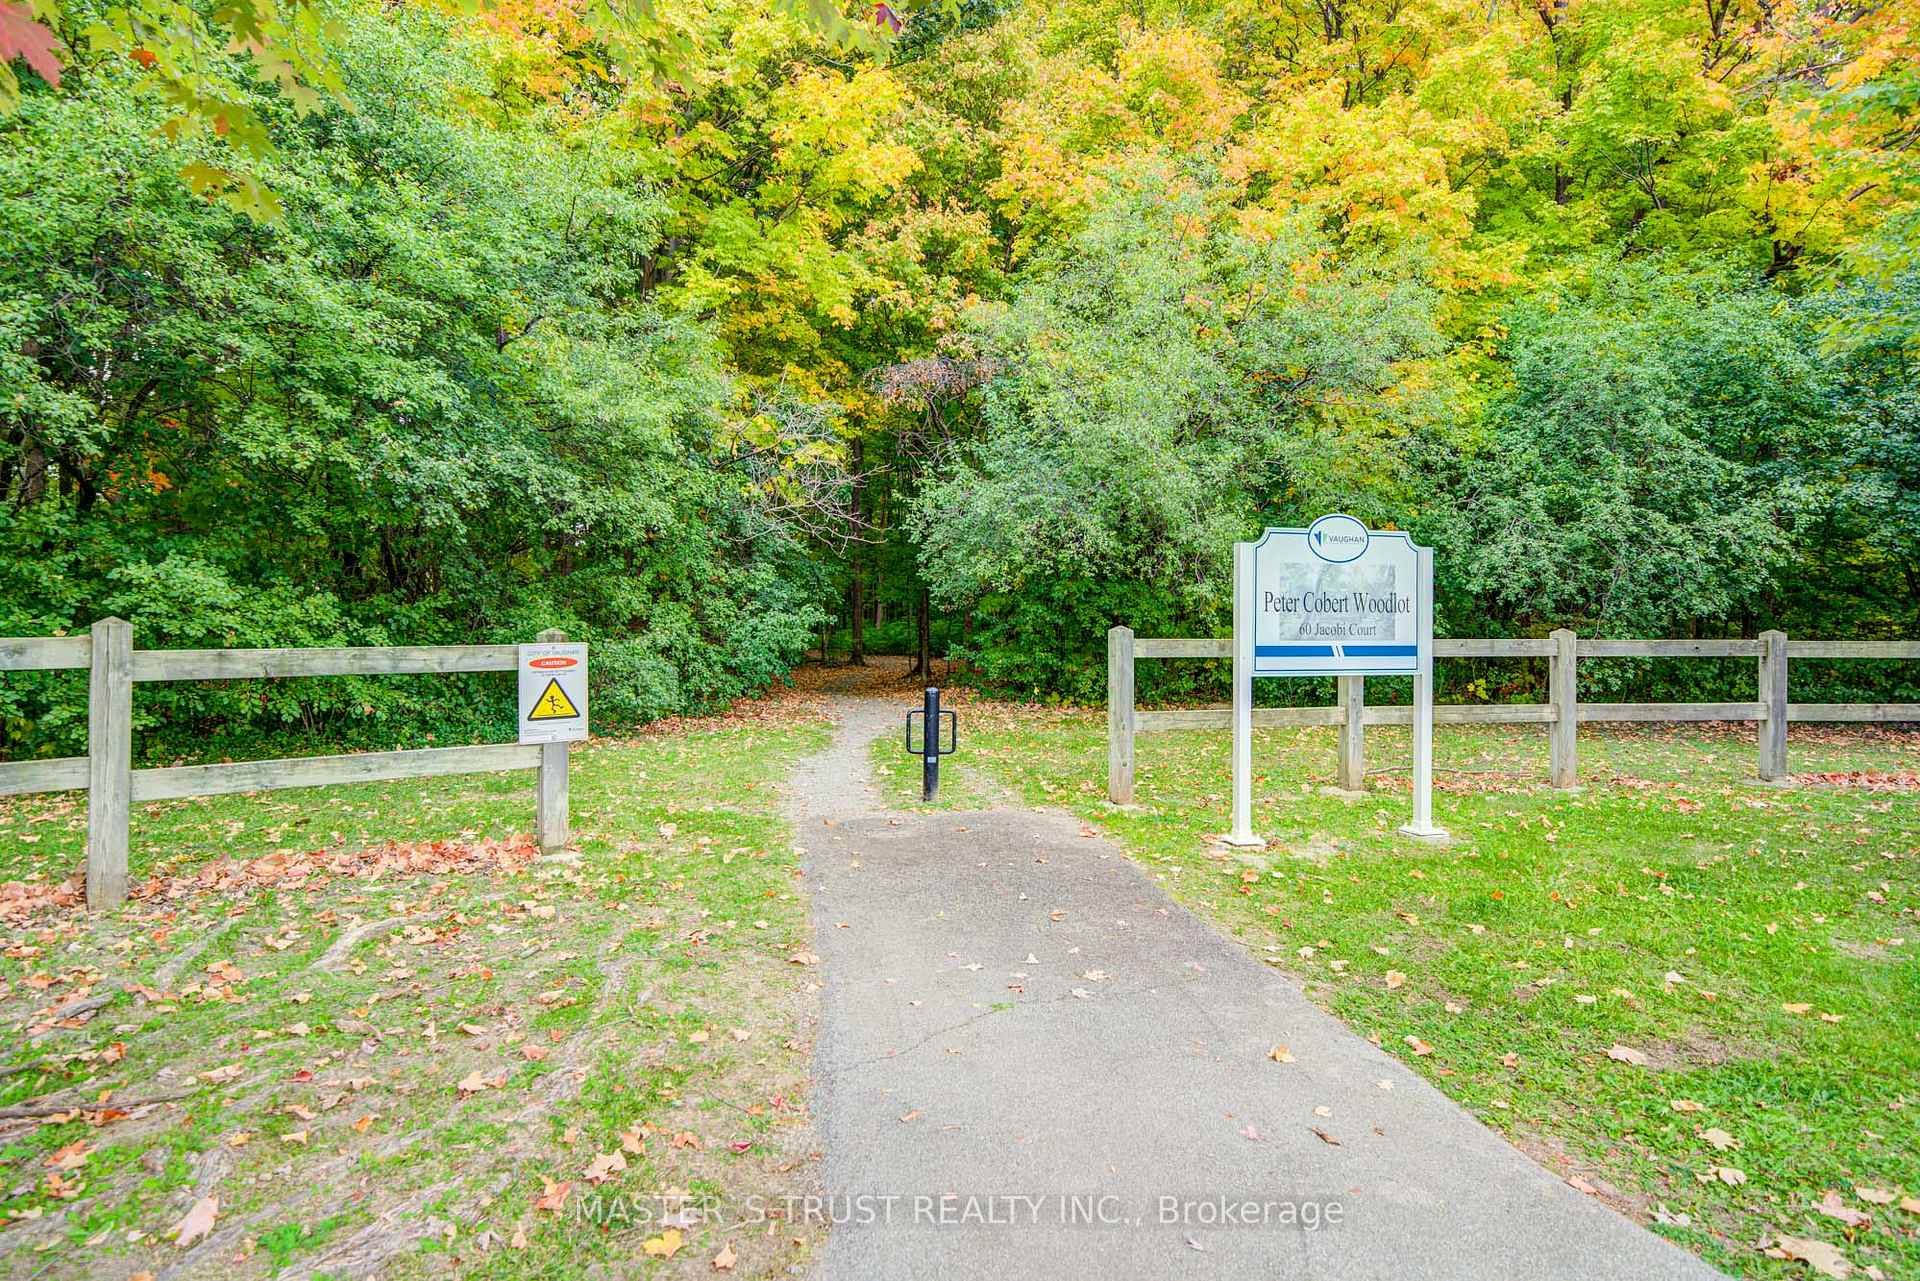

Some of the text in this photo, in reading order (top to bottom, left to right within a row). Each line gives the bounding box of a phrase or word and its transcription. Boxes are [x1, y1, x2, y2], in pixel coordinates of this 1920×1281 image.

[1329, 535, 1365, 544] VAUGHAN
[1264, 591, 1411, 614] Peter Cobert Woodlot
[1299, 623, 1377, 636] 60 Jacobi Court
